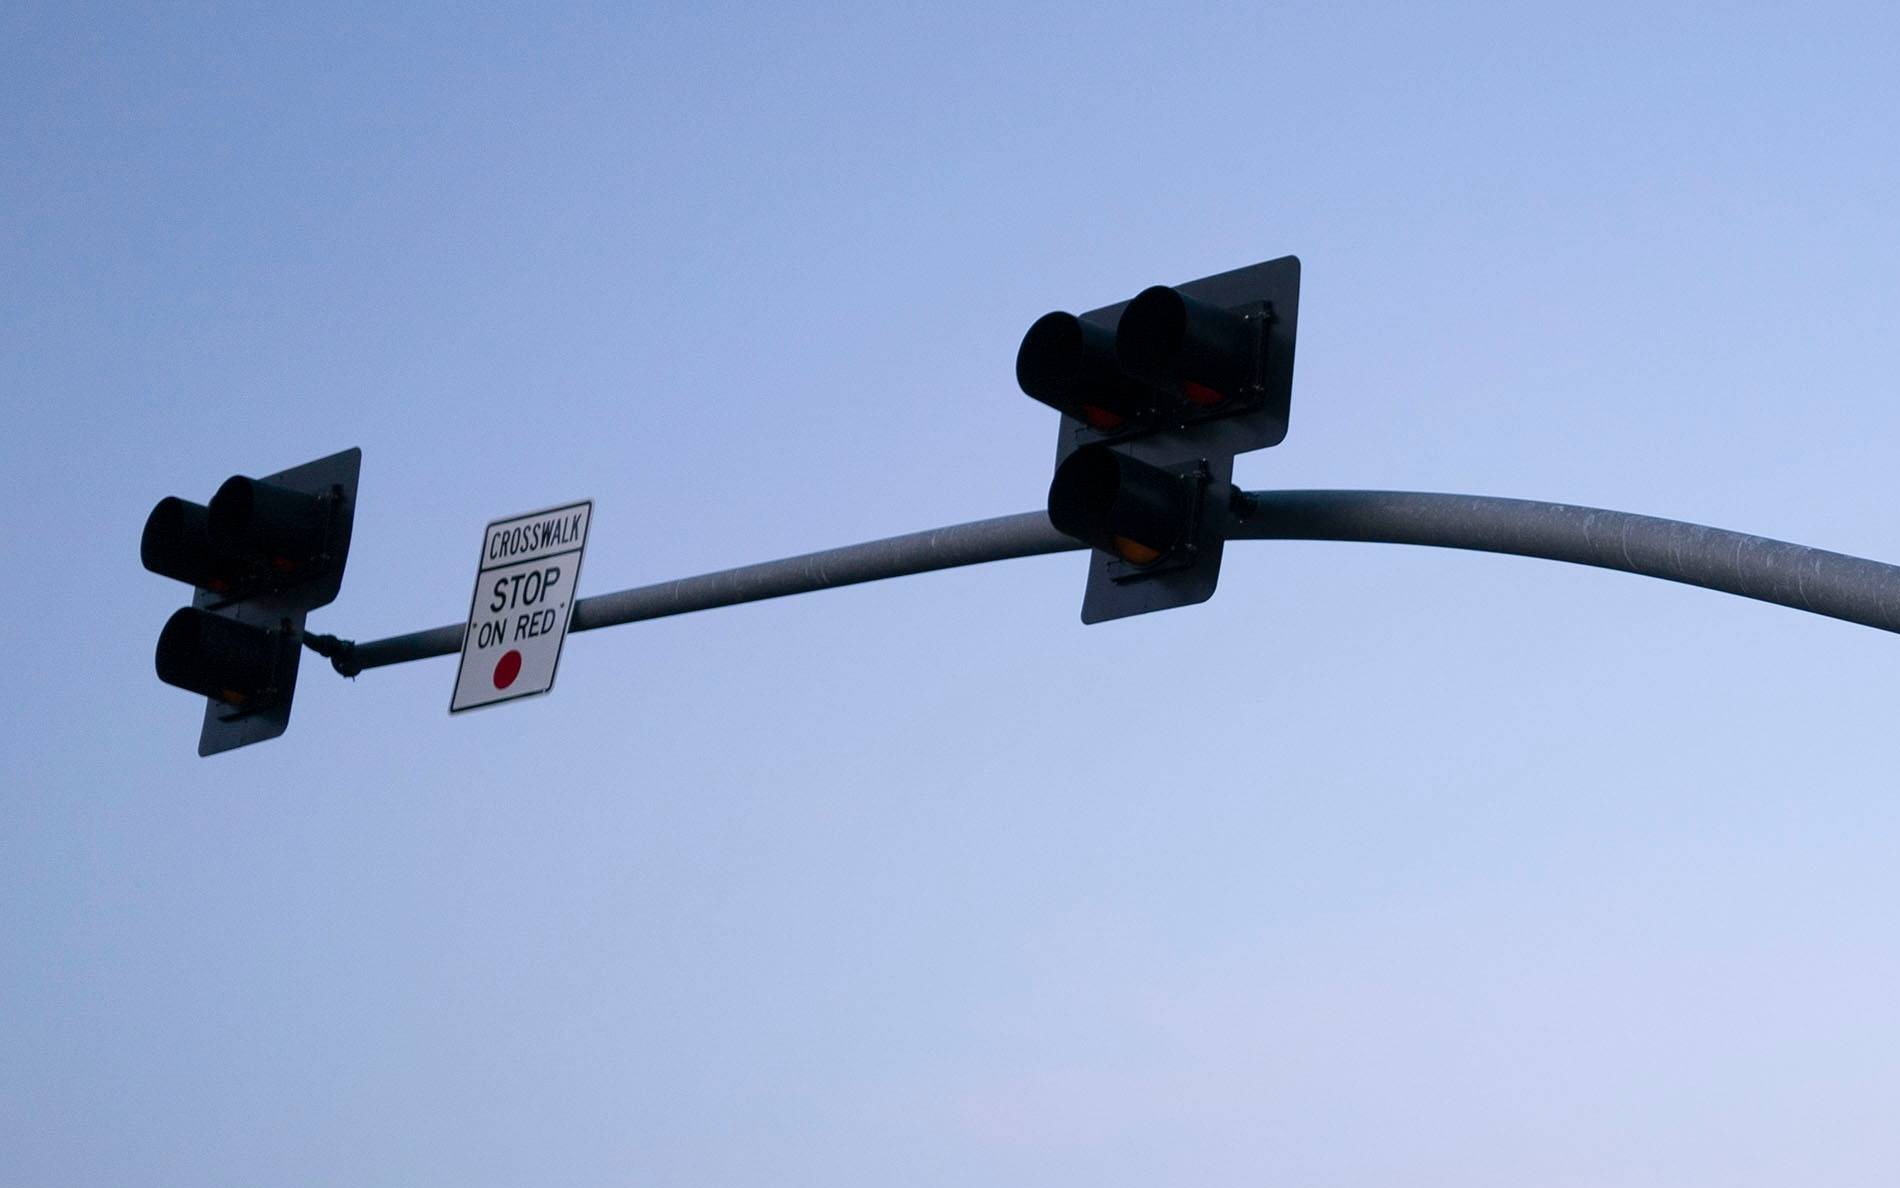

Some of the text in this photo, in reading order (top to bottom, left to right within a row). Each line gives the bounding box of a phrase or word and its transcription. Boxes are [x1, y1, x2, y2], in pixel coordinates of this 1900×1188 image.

[489, 513, 582, 560] CROSSWALK
[490, 567, 560, 613] STOP
[478, 608, 556, 649] ON RED
